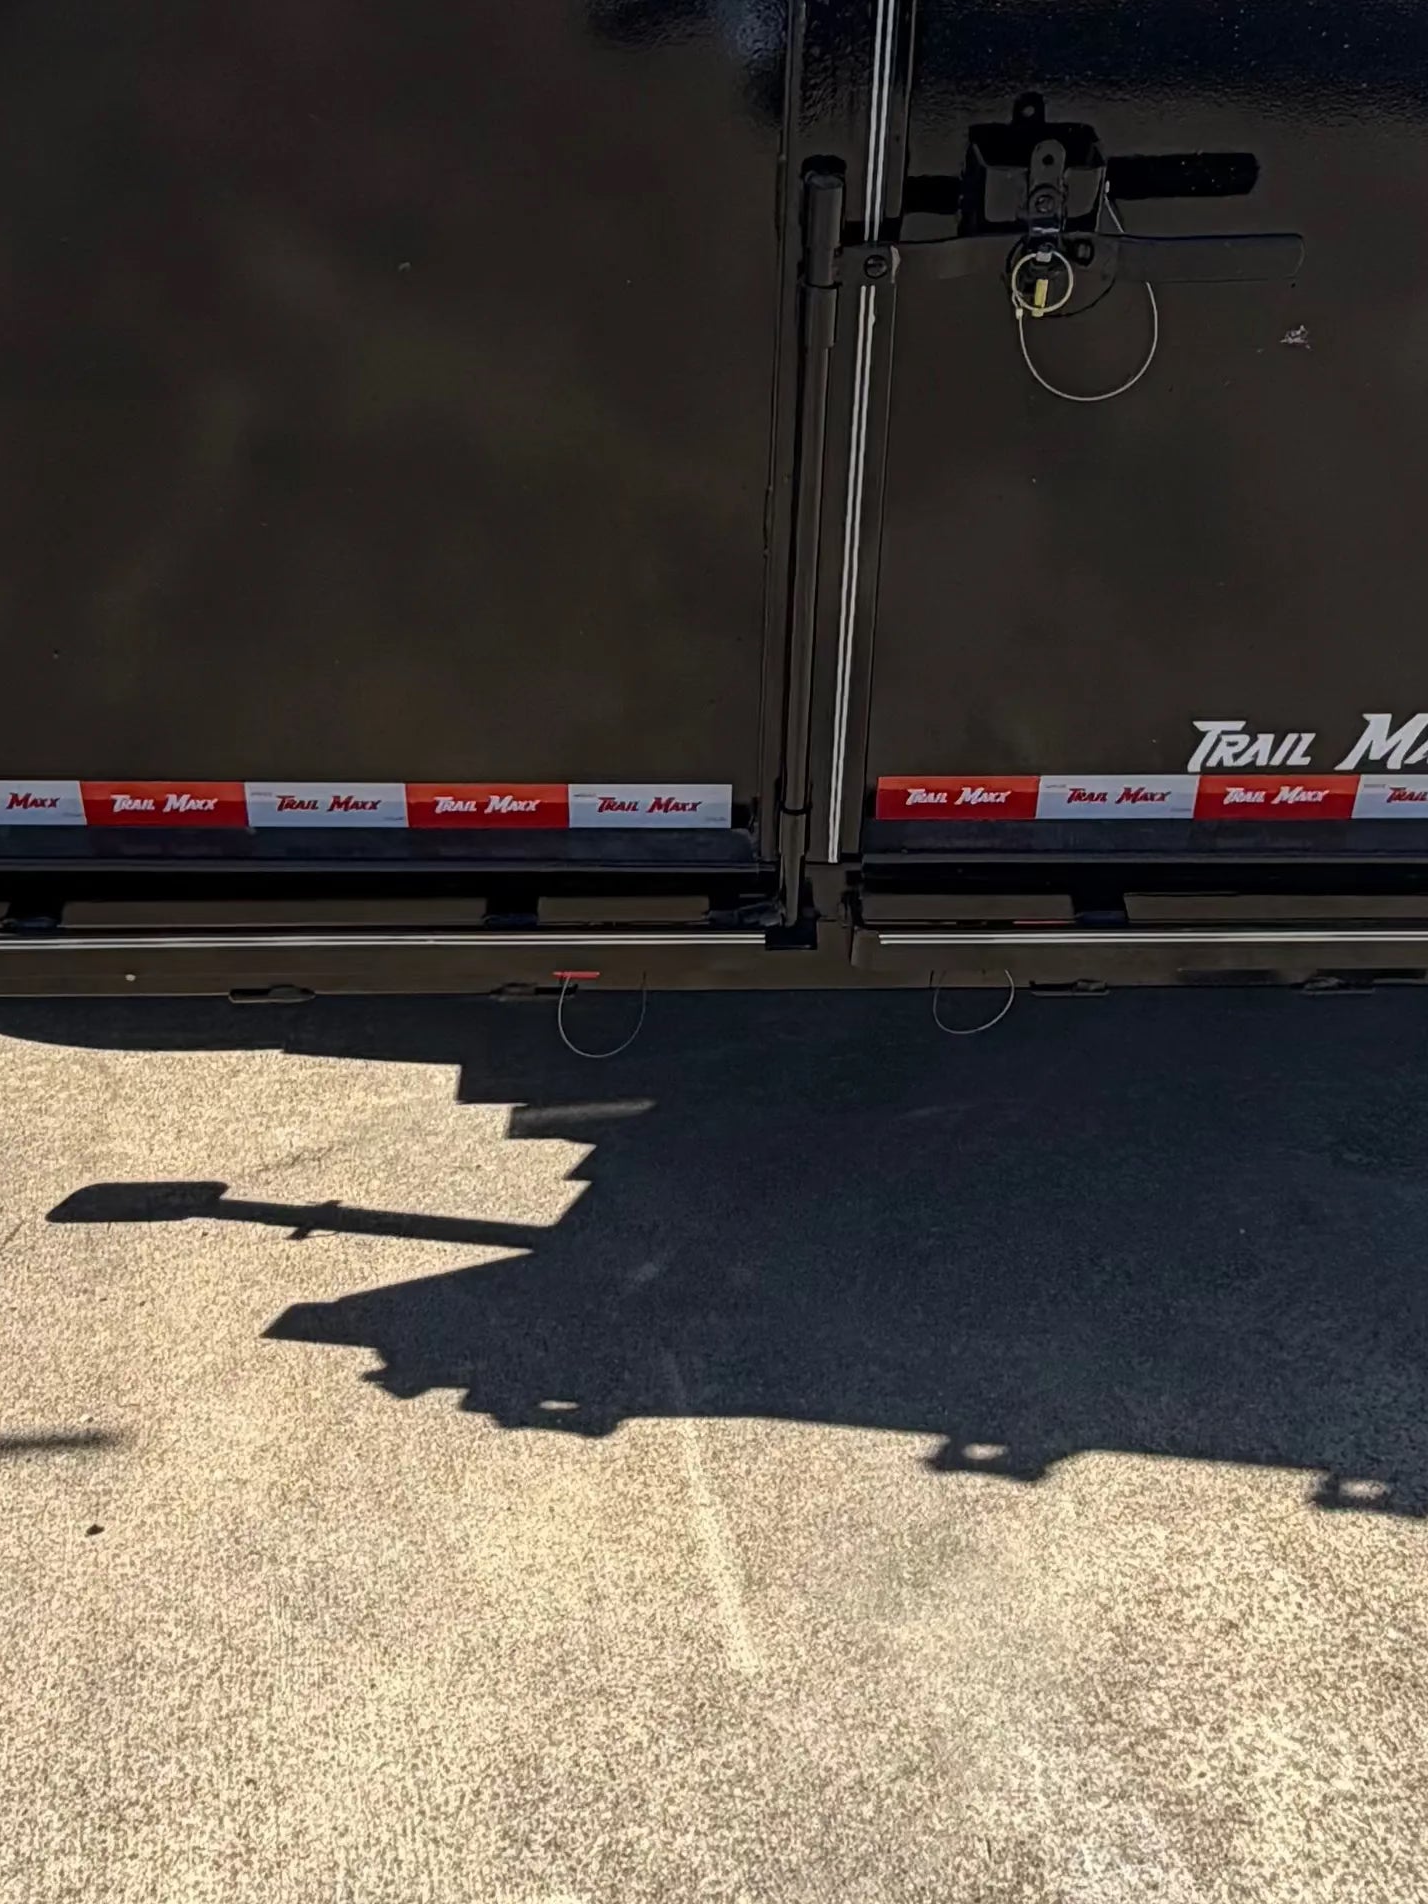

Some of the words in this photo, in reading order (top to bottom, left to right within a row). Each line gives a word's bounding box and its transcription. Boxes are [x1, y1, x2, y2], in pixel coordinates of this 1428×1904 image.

[1187, 720, 1317, 773] TRAIL
[6, 792, 60, 809] MAXX
[110, 795, 155, 812] TRAIL
[162, 793, 218, 812] MAXX
[275, 795, 319, 812] TRAIL
[326, 795, 382, 811] MAXX
[433, 796, 477, 813] TRAIL
[484, 795, 540, 813] MAXX
[597, 797, 640, 813] TRAIL
[646, 797, 702, 813] MAXX
